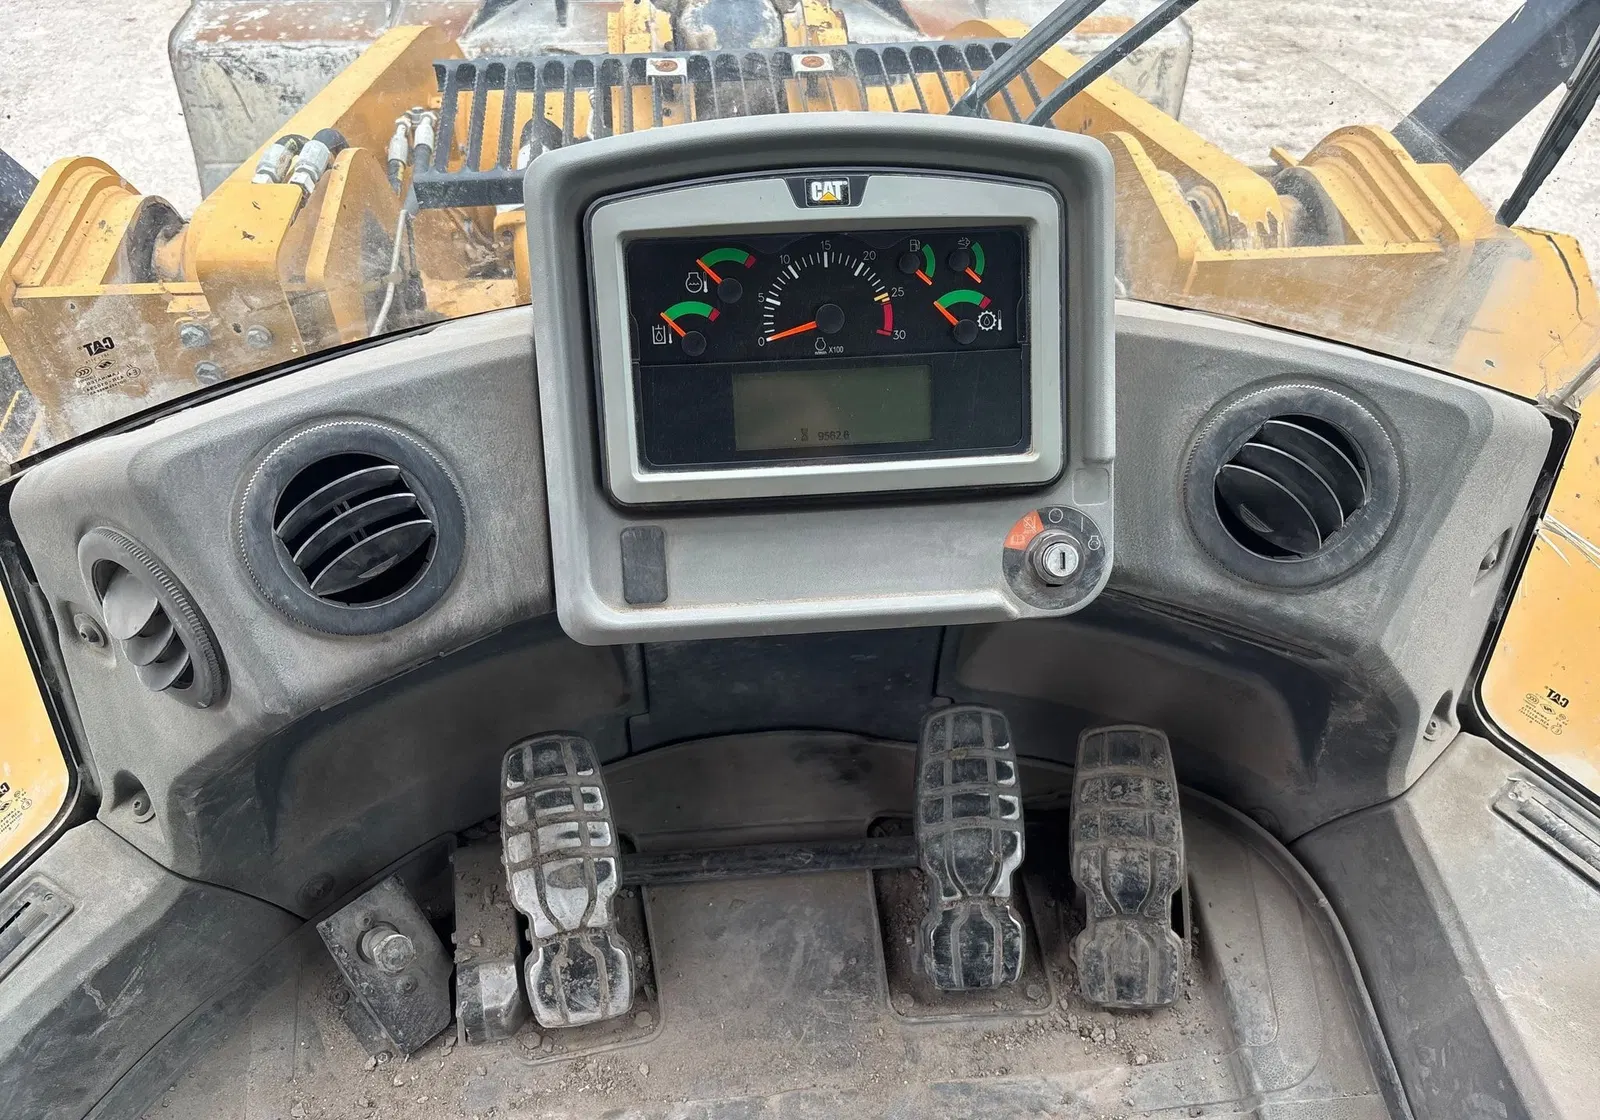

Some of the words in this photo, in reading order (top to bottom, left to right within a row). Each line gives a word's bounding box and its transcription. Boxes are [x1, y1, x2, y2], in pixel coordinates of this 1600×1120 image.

[811, 180, 843, 202] CAT
[820, 240, 832, 251] 15
[779, 253, 791, 265] 10
[862, 250, 877, 261] 20
[757, 292, 765, 303] 5
[891, 286, 905, 298] 25
[892, 329, 907, 340] 30
[757, 336, 765, 347] 0
